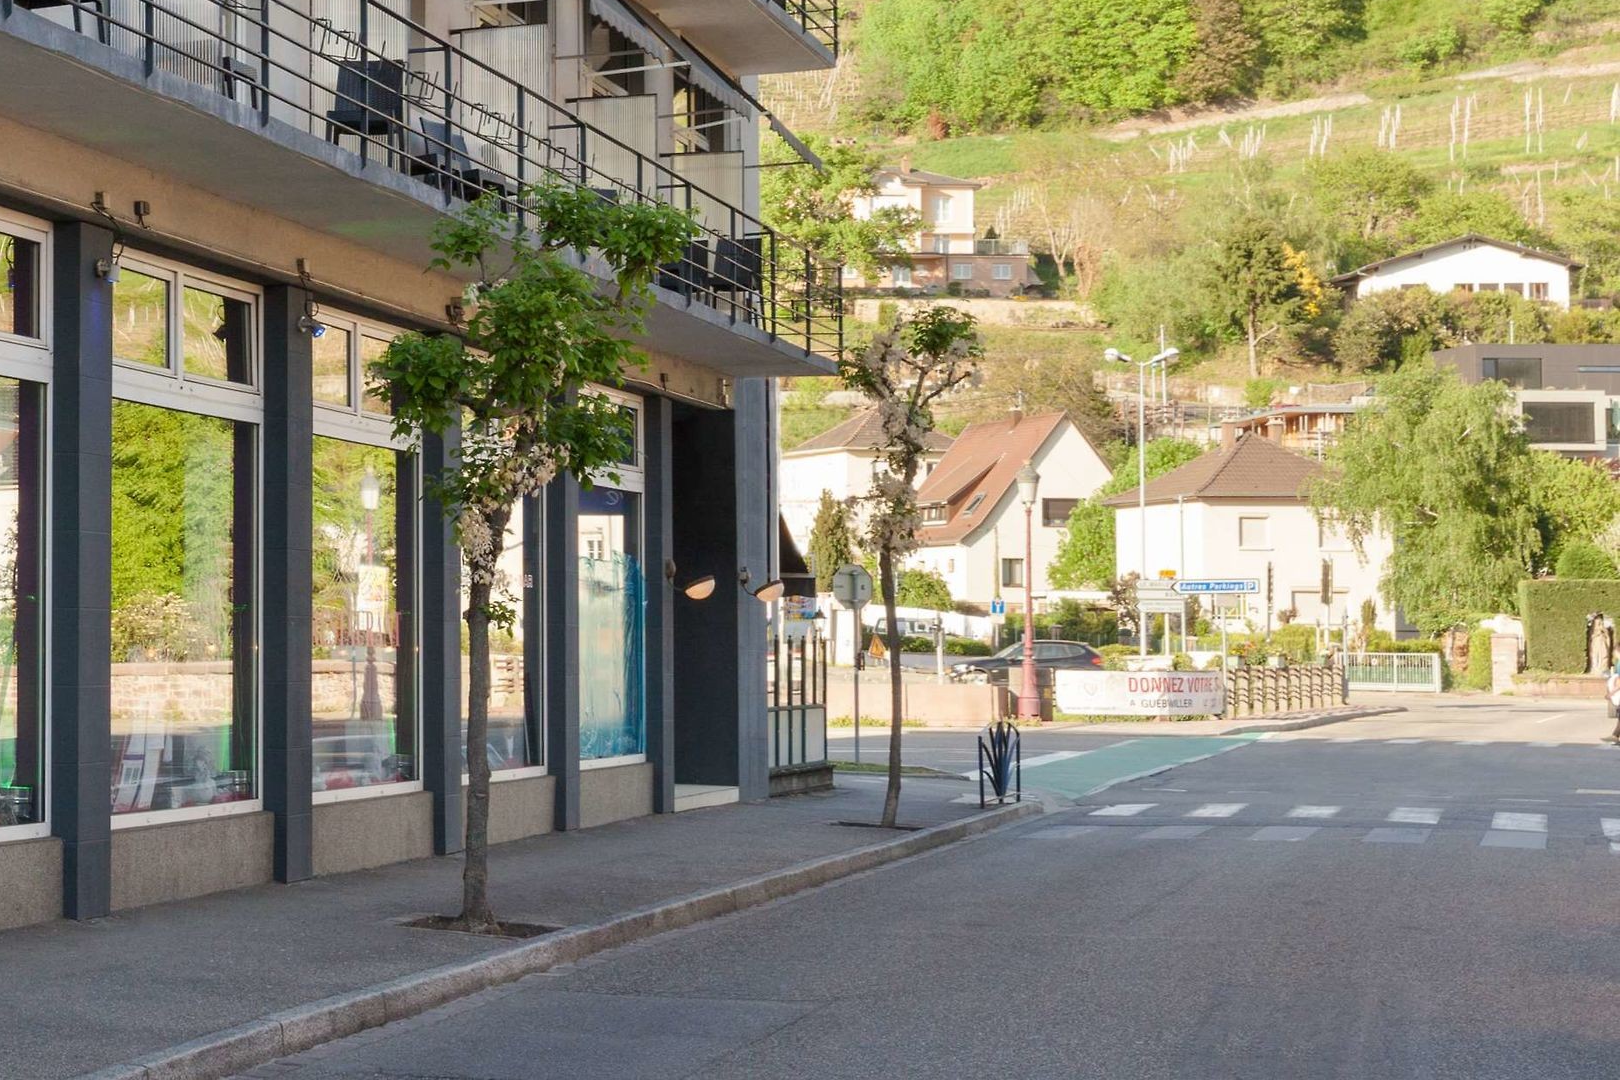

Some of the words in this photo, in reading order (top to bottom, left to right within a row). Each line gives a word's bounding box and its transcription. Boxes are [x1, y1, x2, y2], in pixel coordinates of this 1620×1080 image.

[1181, 582, 1207, 591] Autres
[1209, 582, 1244, 592] Parkings
[1128, 677, 1184, 693] DONNEZ
[1187, 677, 1213, 693] VOTRE
[1141, 698, 1193, 709] GUEBWILLER
